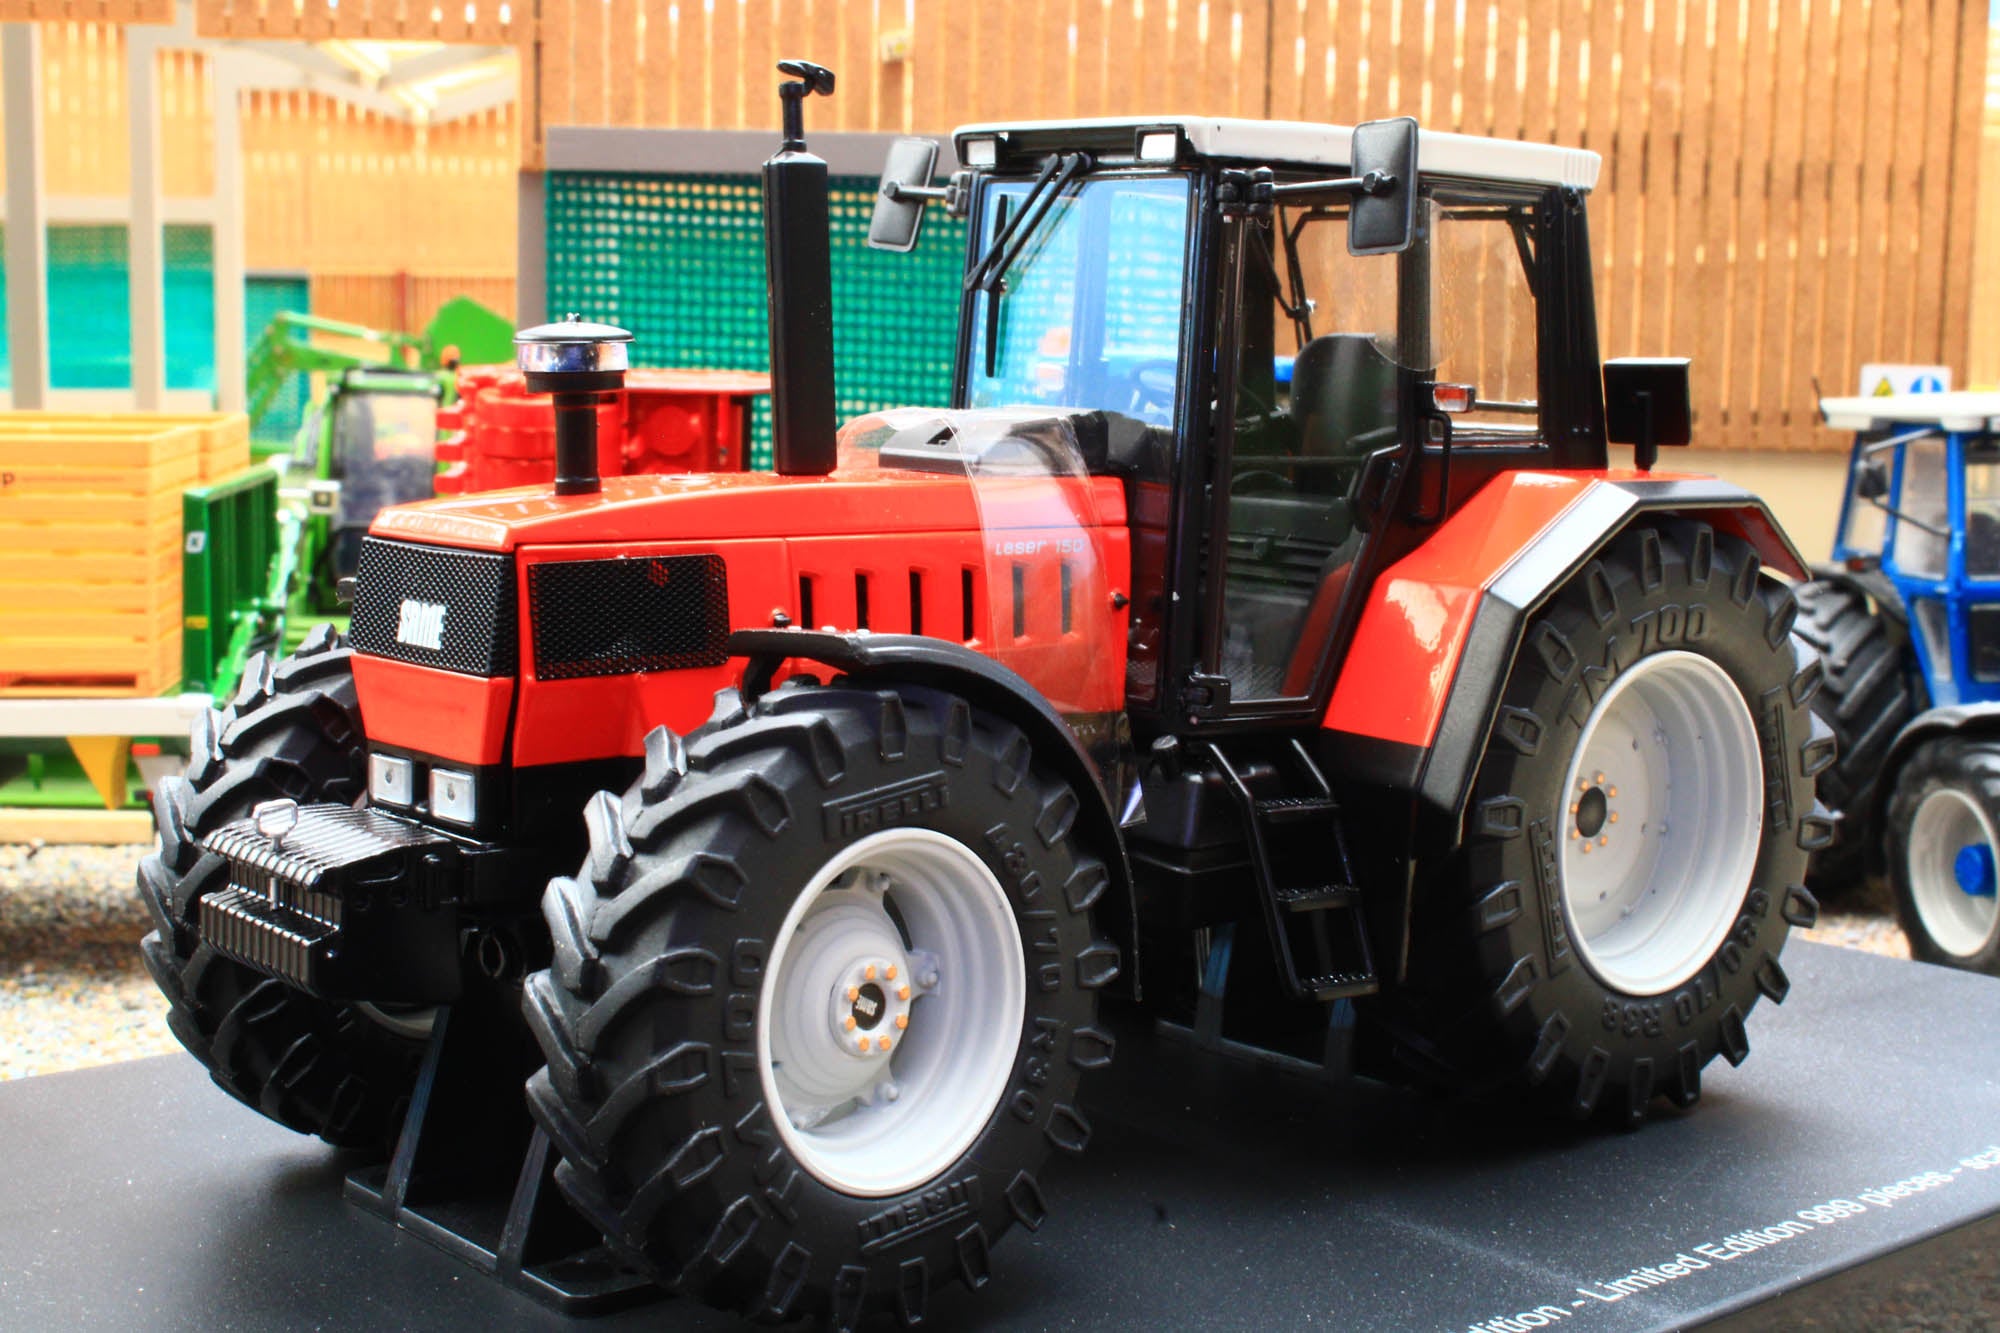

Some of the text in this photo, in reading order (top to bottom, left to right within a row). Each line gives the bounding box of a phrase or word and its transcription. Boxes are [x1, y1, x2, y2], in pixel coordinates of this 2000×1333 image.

[1055, 537, 1085, 554] 150
[396, 599, 447, 651] SAME
[1629, 603, 1712, 655] 700
[821, 769, 949, 842] PIRELLI
[857, 1173, 981, 1253] PIRELLI
[1575, 1252, 1712, 1302] Limited
[1692, 1219, 1815, 1261] Edition
[1796, 1198, 1868, 1225] 999
[1856, 1170, 1955, 1208] pieces
